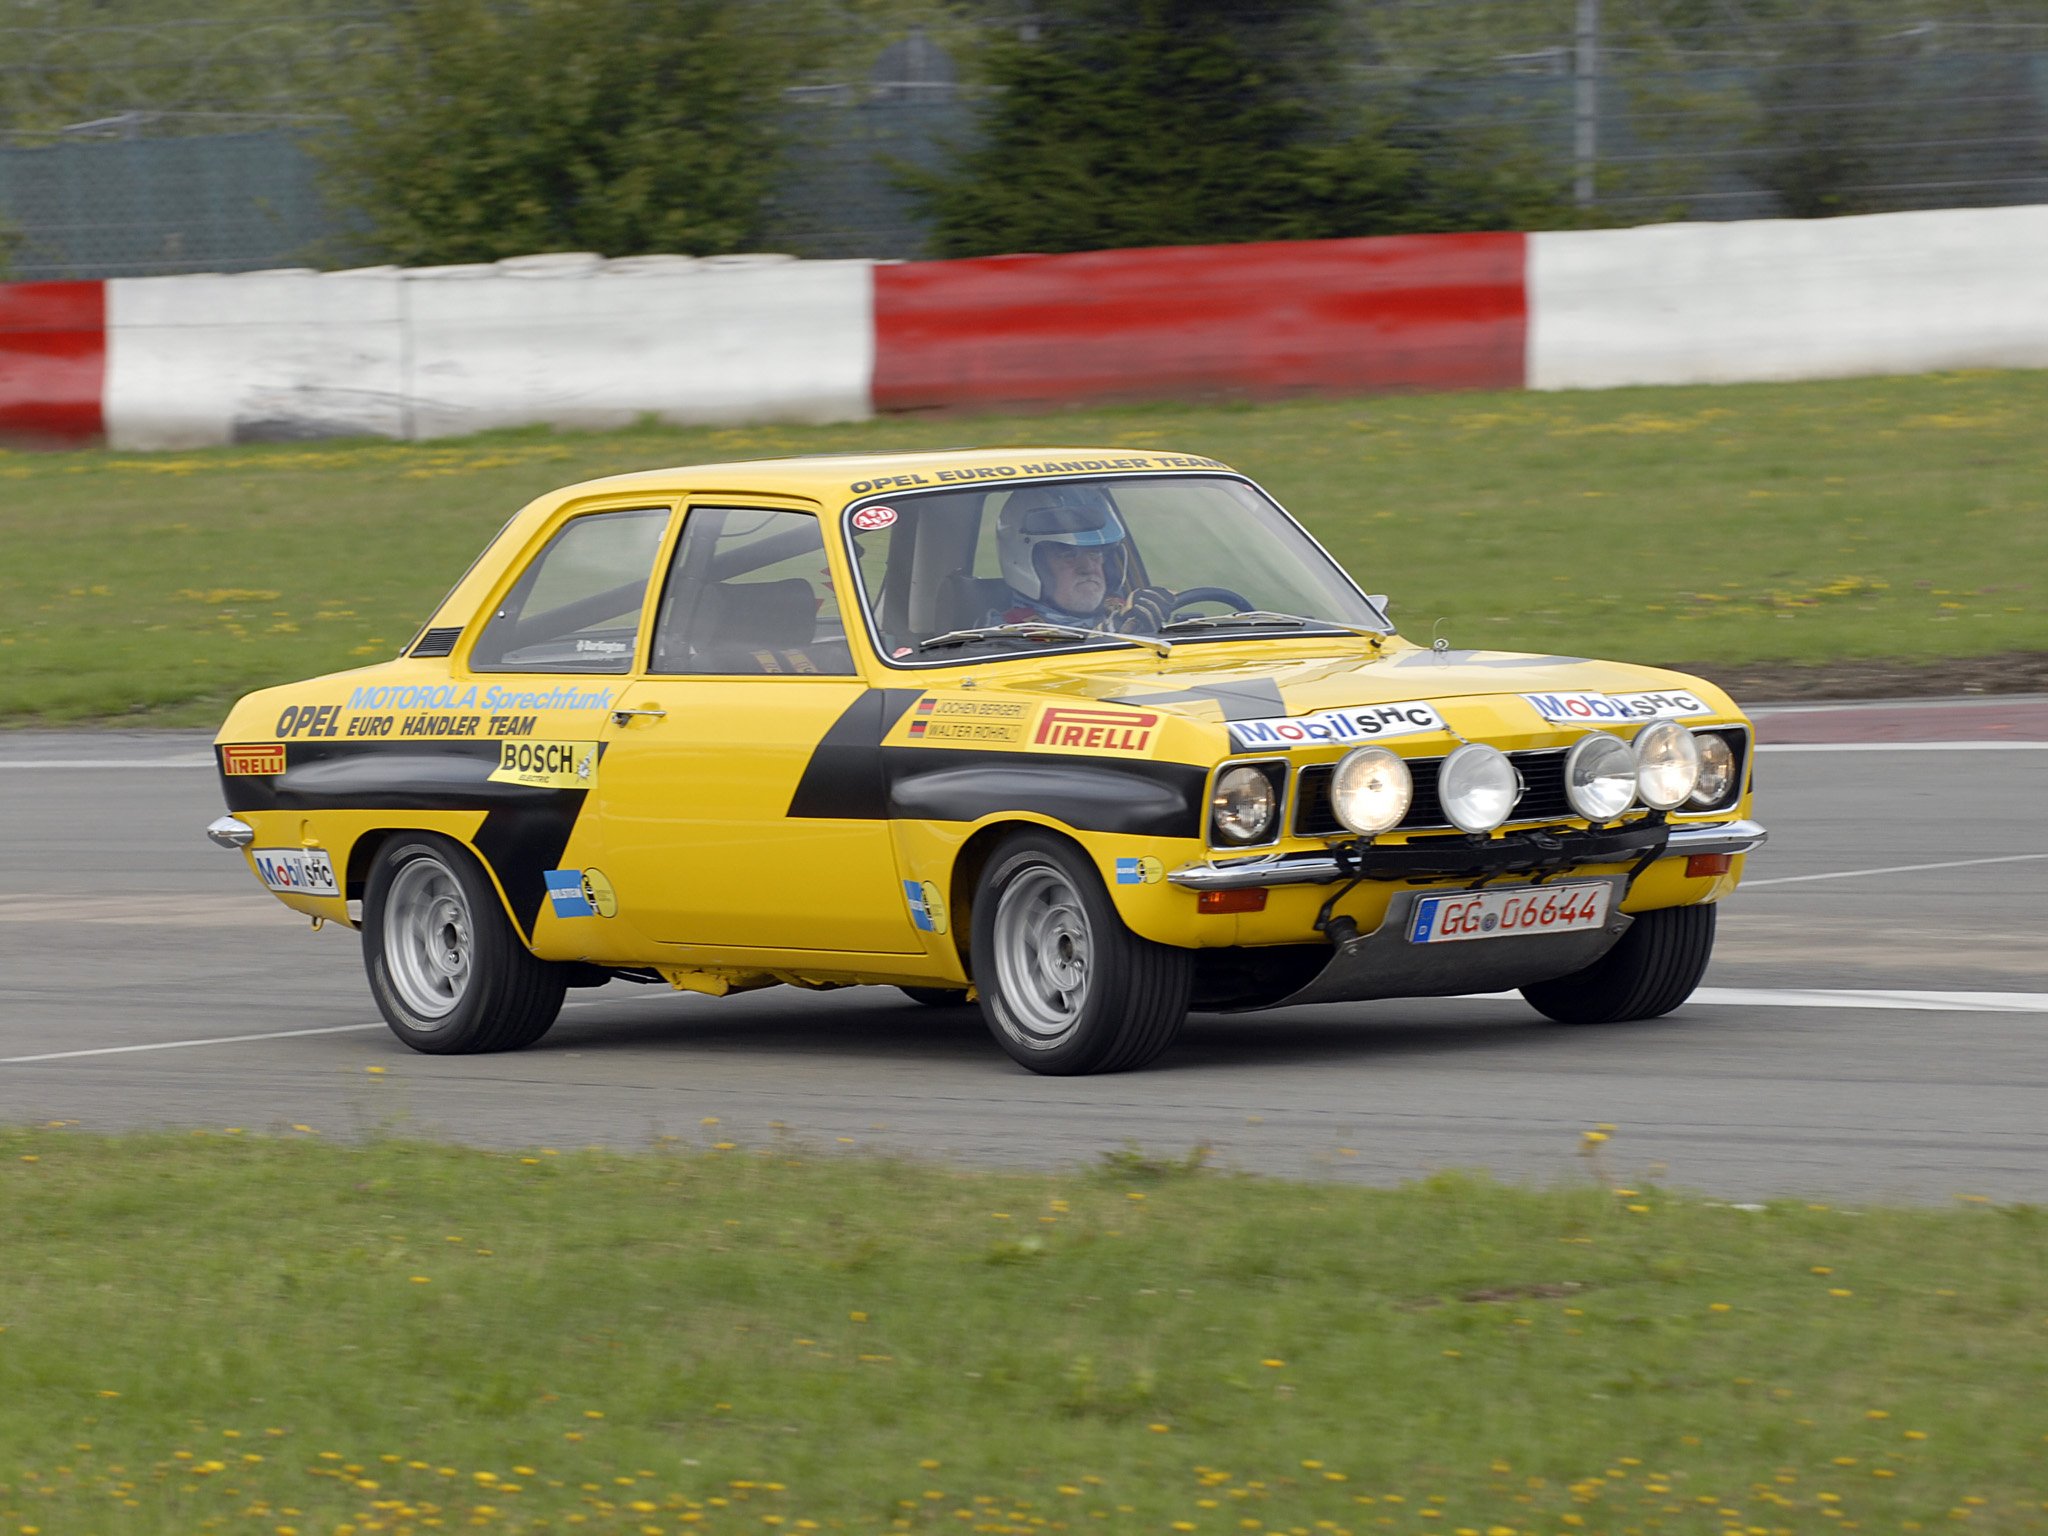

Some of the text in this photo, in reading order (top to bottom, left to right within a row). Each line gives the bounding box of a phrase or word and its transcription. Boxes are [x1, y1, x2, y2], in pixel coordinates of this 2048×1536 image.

[850, 474, 929, 494] OPEL
[935, 466, 1017, 482] EURO
[1152, 457, 1228, 470] TEAM
[346, 685, 615, 714] MOTOROLA Sprechfunk
[1527, 694, 1633, 718] Mobil
[276, 705, 538, 738] OPEL EURO HÄNDLER TEAM
[929, 724, 973, 738] WALTER
[1034, 707, 1158, 751] PIRELLI
[1233, 712, 1358, 742] Mobil
[224, 745, 284, 774] PIRELLI
[501, 744, 573, 774] BOSCH
[256, 857, 308, 887] Mobil
[1440, 891, 1598, 936] GG 06644
